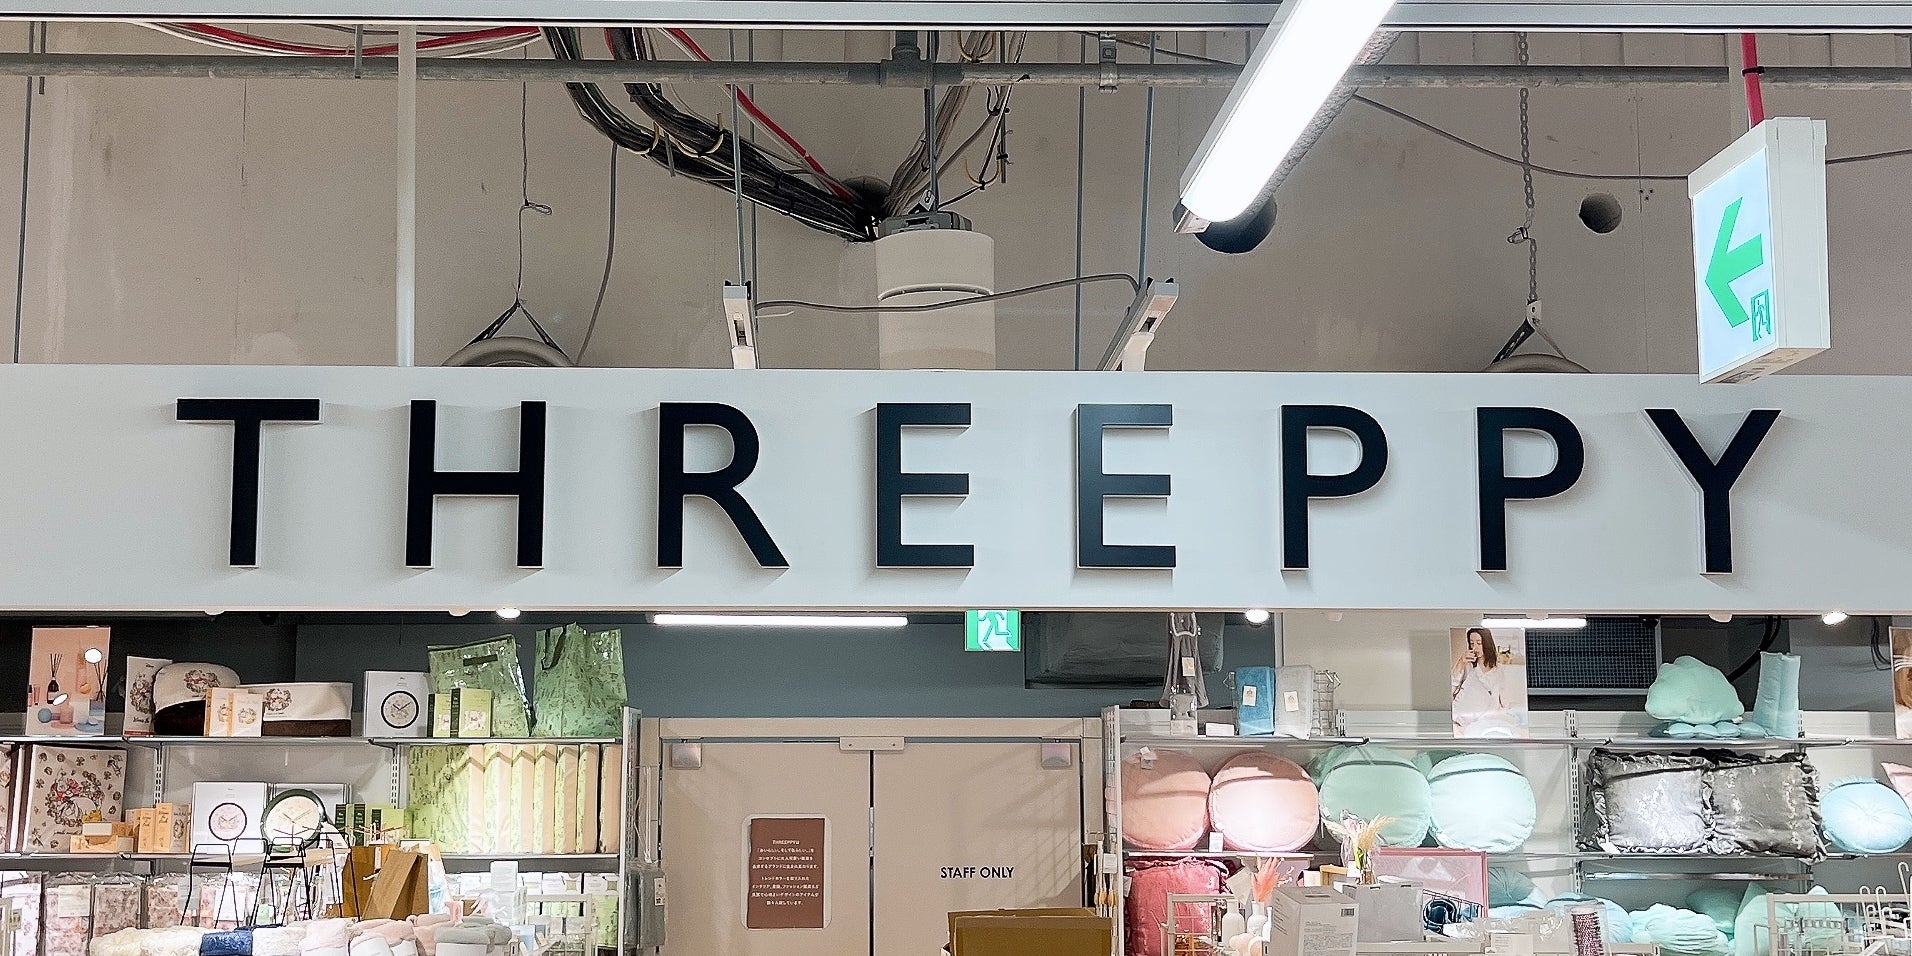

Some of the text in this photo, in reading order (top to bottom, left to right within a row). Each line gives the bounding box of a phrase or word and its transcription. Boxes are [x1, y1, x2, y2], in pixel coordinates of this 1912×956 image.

[177, 398, 1782, 574] THREEPPY
[940, 867, 1014, 878] STAFF ONLY
